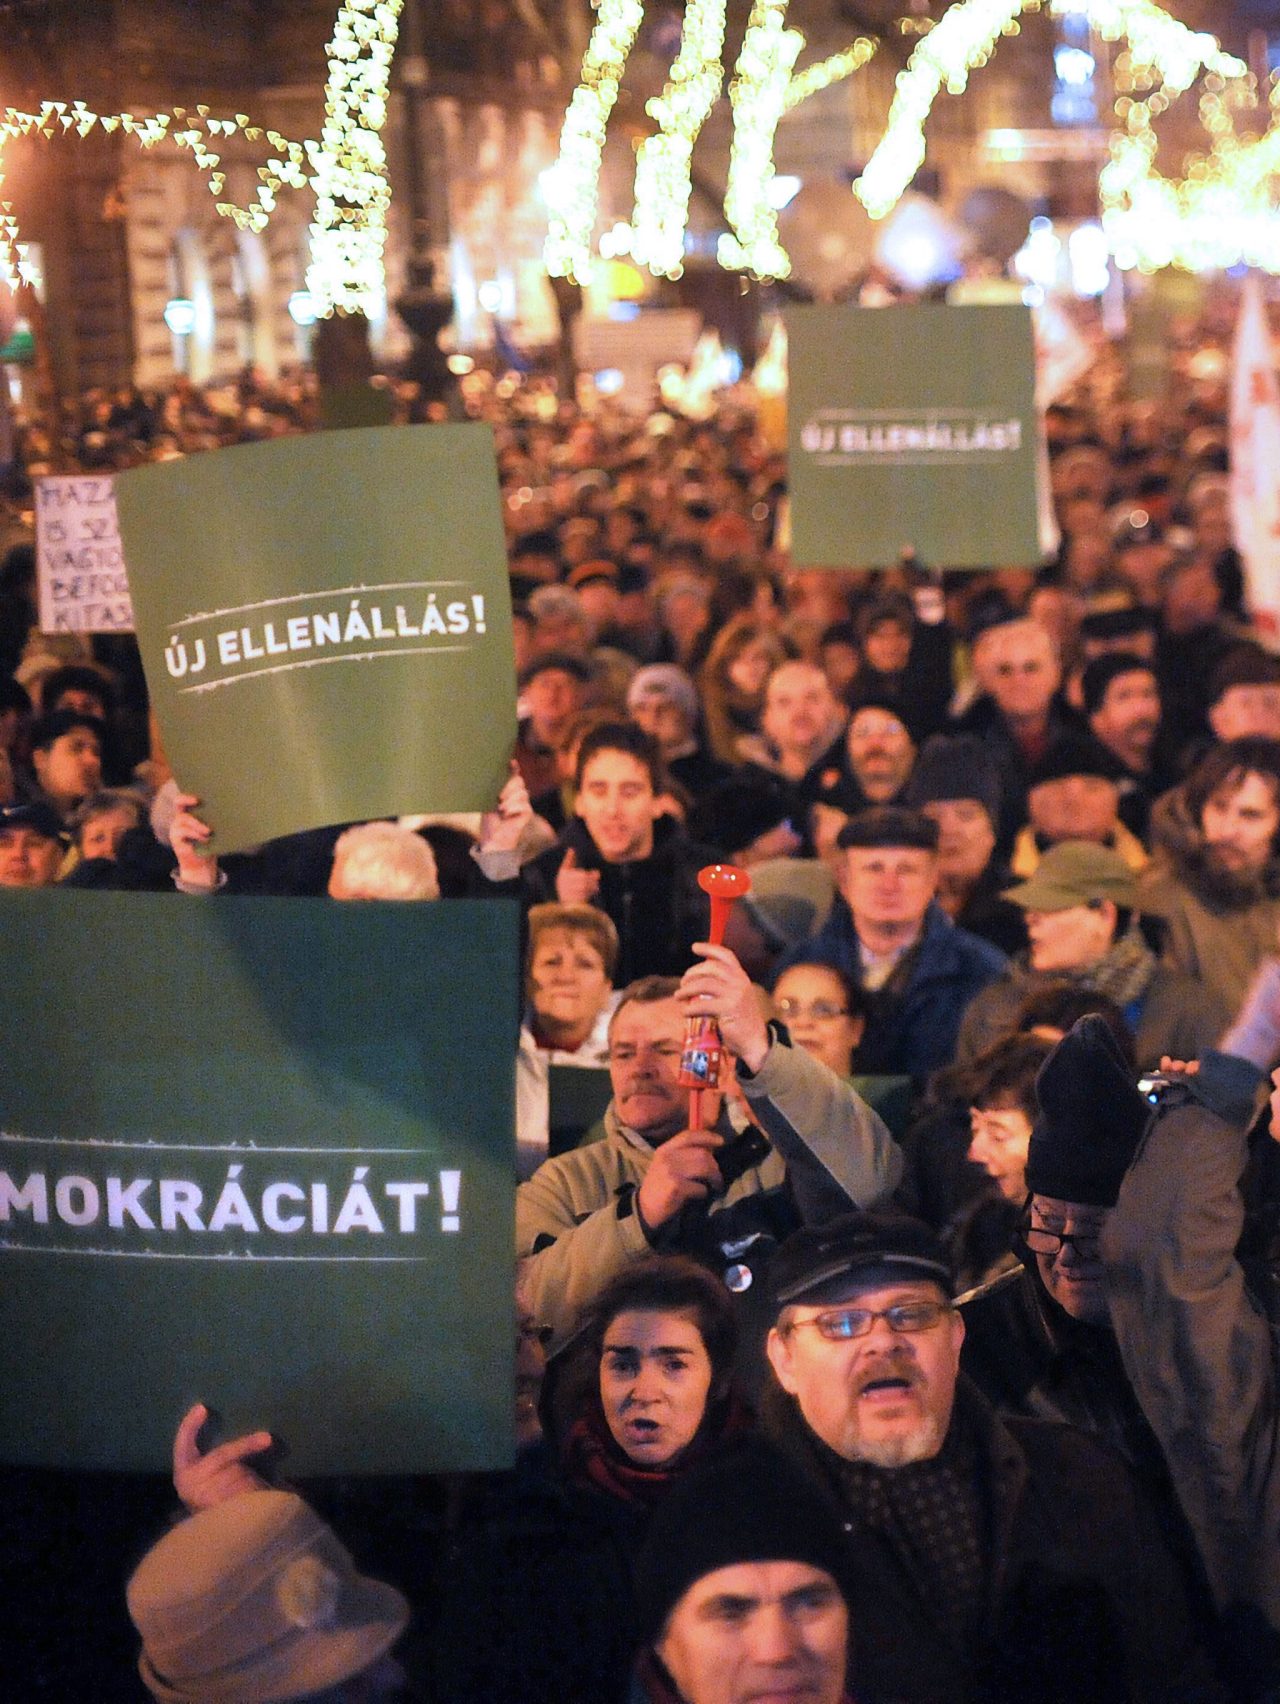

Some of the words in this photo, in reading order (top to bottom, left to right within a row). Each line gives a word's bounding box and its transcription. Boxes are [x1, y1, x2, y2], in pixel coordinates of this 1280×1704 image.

[802, 421, 836, 452] ÚJ
[839, 419, 1022, 450] ELLENÁLLÁS!
[165, 634, 206, 677] ÚJ
[217, 594, 486, 665] ELLENÁLLÁS!
[0, 1164, 461, 1234] MOKRÁCIÁT!
